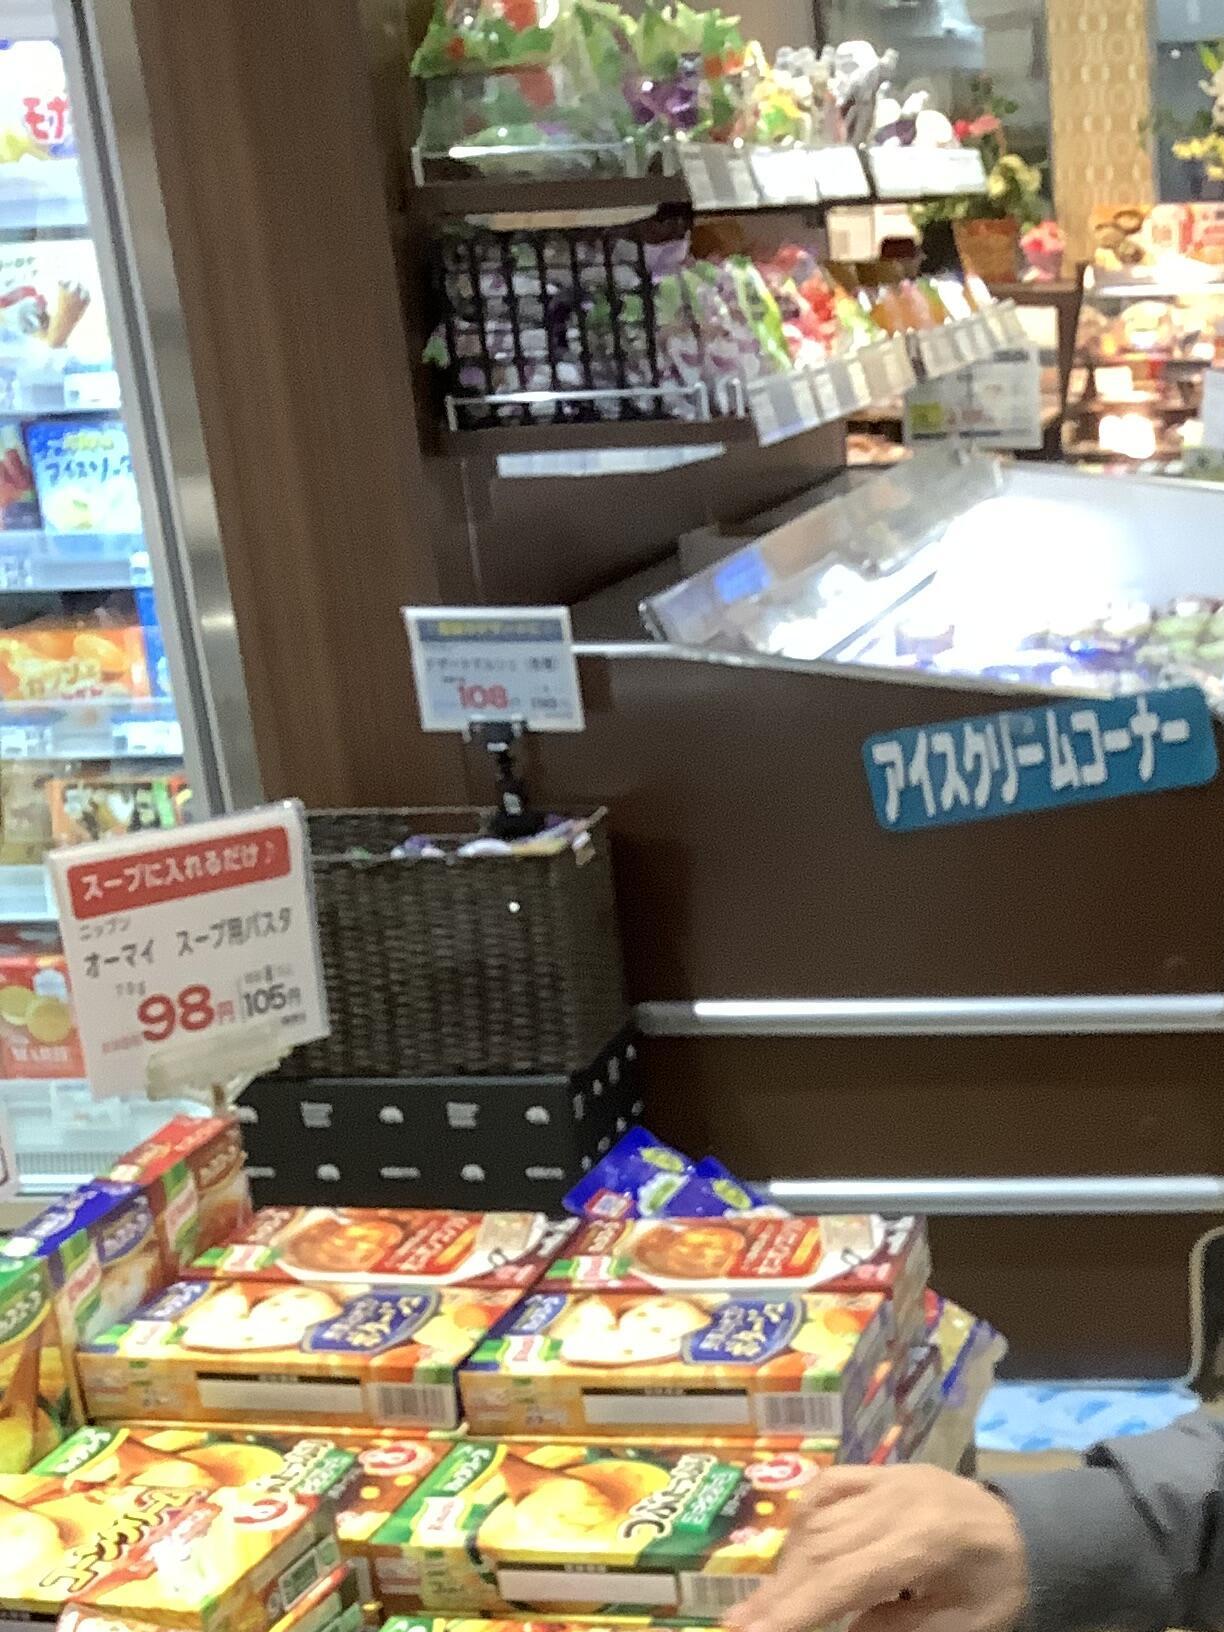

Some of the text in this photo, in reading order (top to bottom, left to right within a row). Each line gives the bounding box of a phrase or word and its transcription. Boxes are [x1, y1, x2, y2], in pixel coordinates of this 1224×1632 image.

[872, 695, 1191, 823] アイスクリームコーナー
[80, 842, 260, 901] スープに入れるだけ
[84, 907, 293, 979] オーマイ スープ用パスタ
